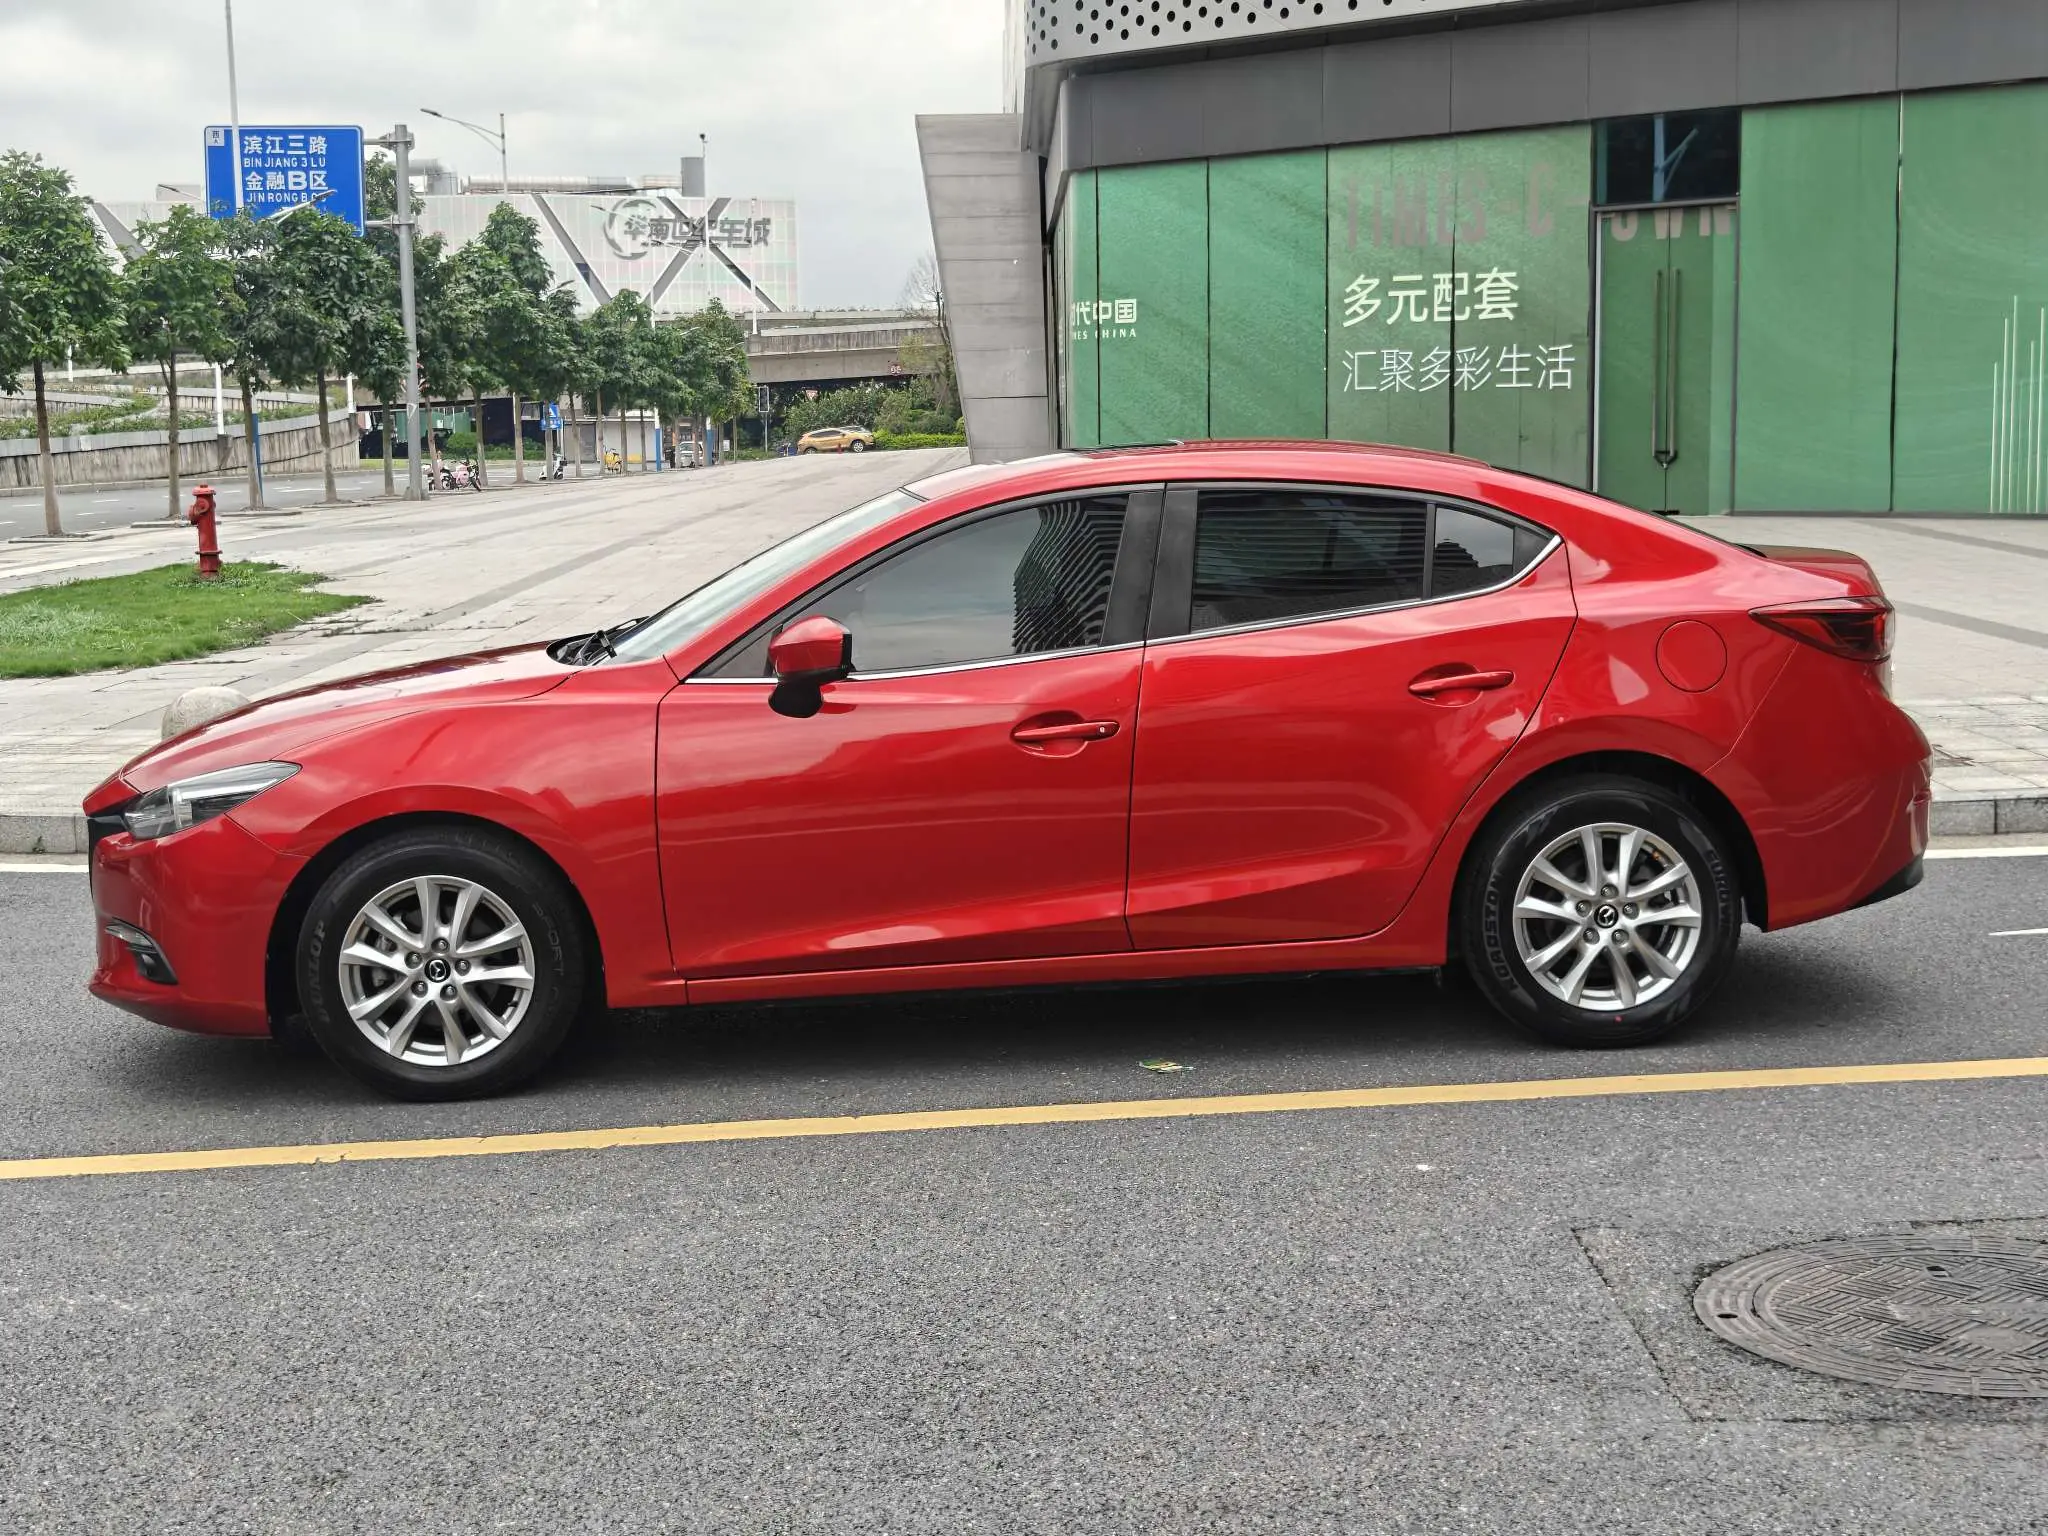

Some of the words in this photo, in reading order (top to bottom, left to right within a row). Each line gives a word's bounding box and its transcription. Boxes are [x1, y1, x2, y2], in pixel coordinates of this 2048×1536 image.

[243, 135, 328, 155] 滨江三路
[301, 157, 308, 168] 3
[311, 157, 326, 168] LU
[245, 171, 329, 191] 金融B区
[1342, 267, 1520, 328] 多元配套
[1342, 344, 1576, 393] 汇聚多彩生活
